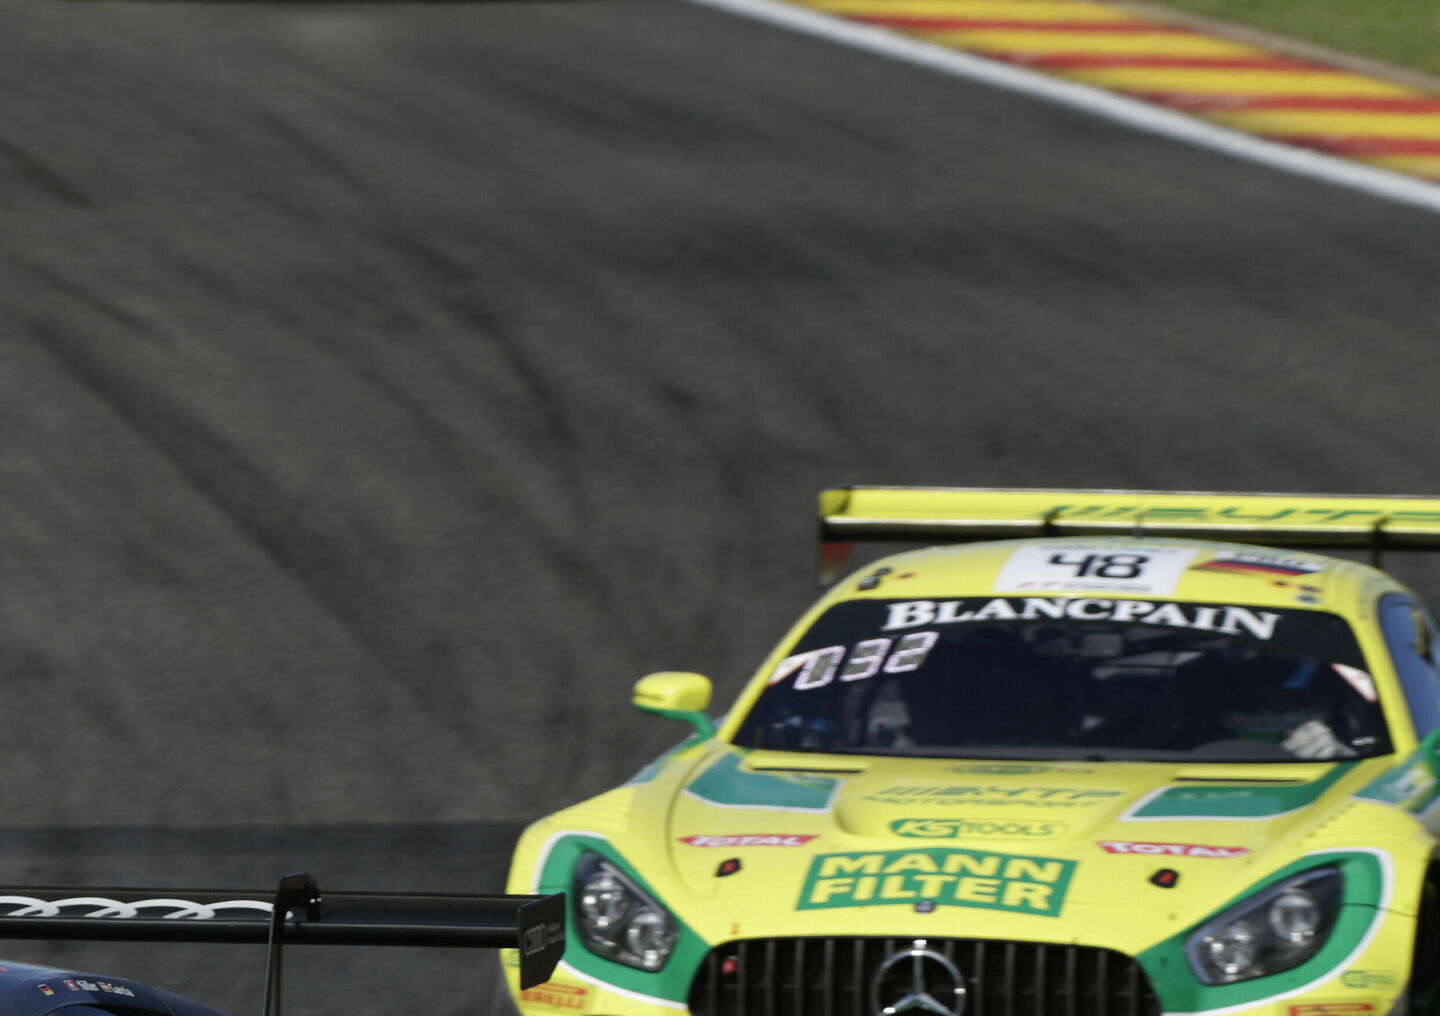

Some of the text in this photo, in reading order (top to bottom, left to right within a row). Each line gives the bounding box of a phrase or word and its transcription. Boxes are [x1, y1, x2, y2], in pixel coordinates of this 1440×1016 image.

[1047, 552, 1152, 580] 48
[881, 597, 1283, 641] BLANCPAIN
[690, 835, 805, 847] TOTAL
[961, 821, 1056, 837] TOOLS
[1100, 841, 1249, 858] TOTAL
[818, 853, 1064, 883] MANN
[808, 874, 1055, 910] FILTER
